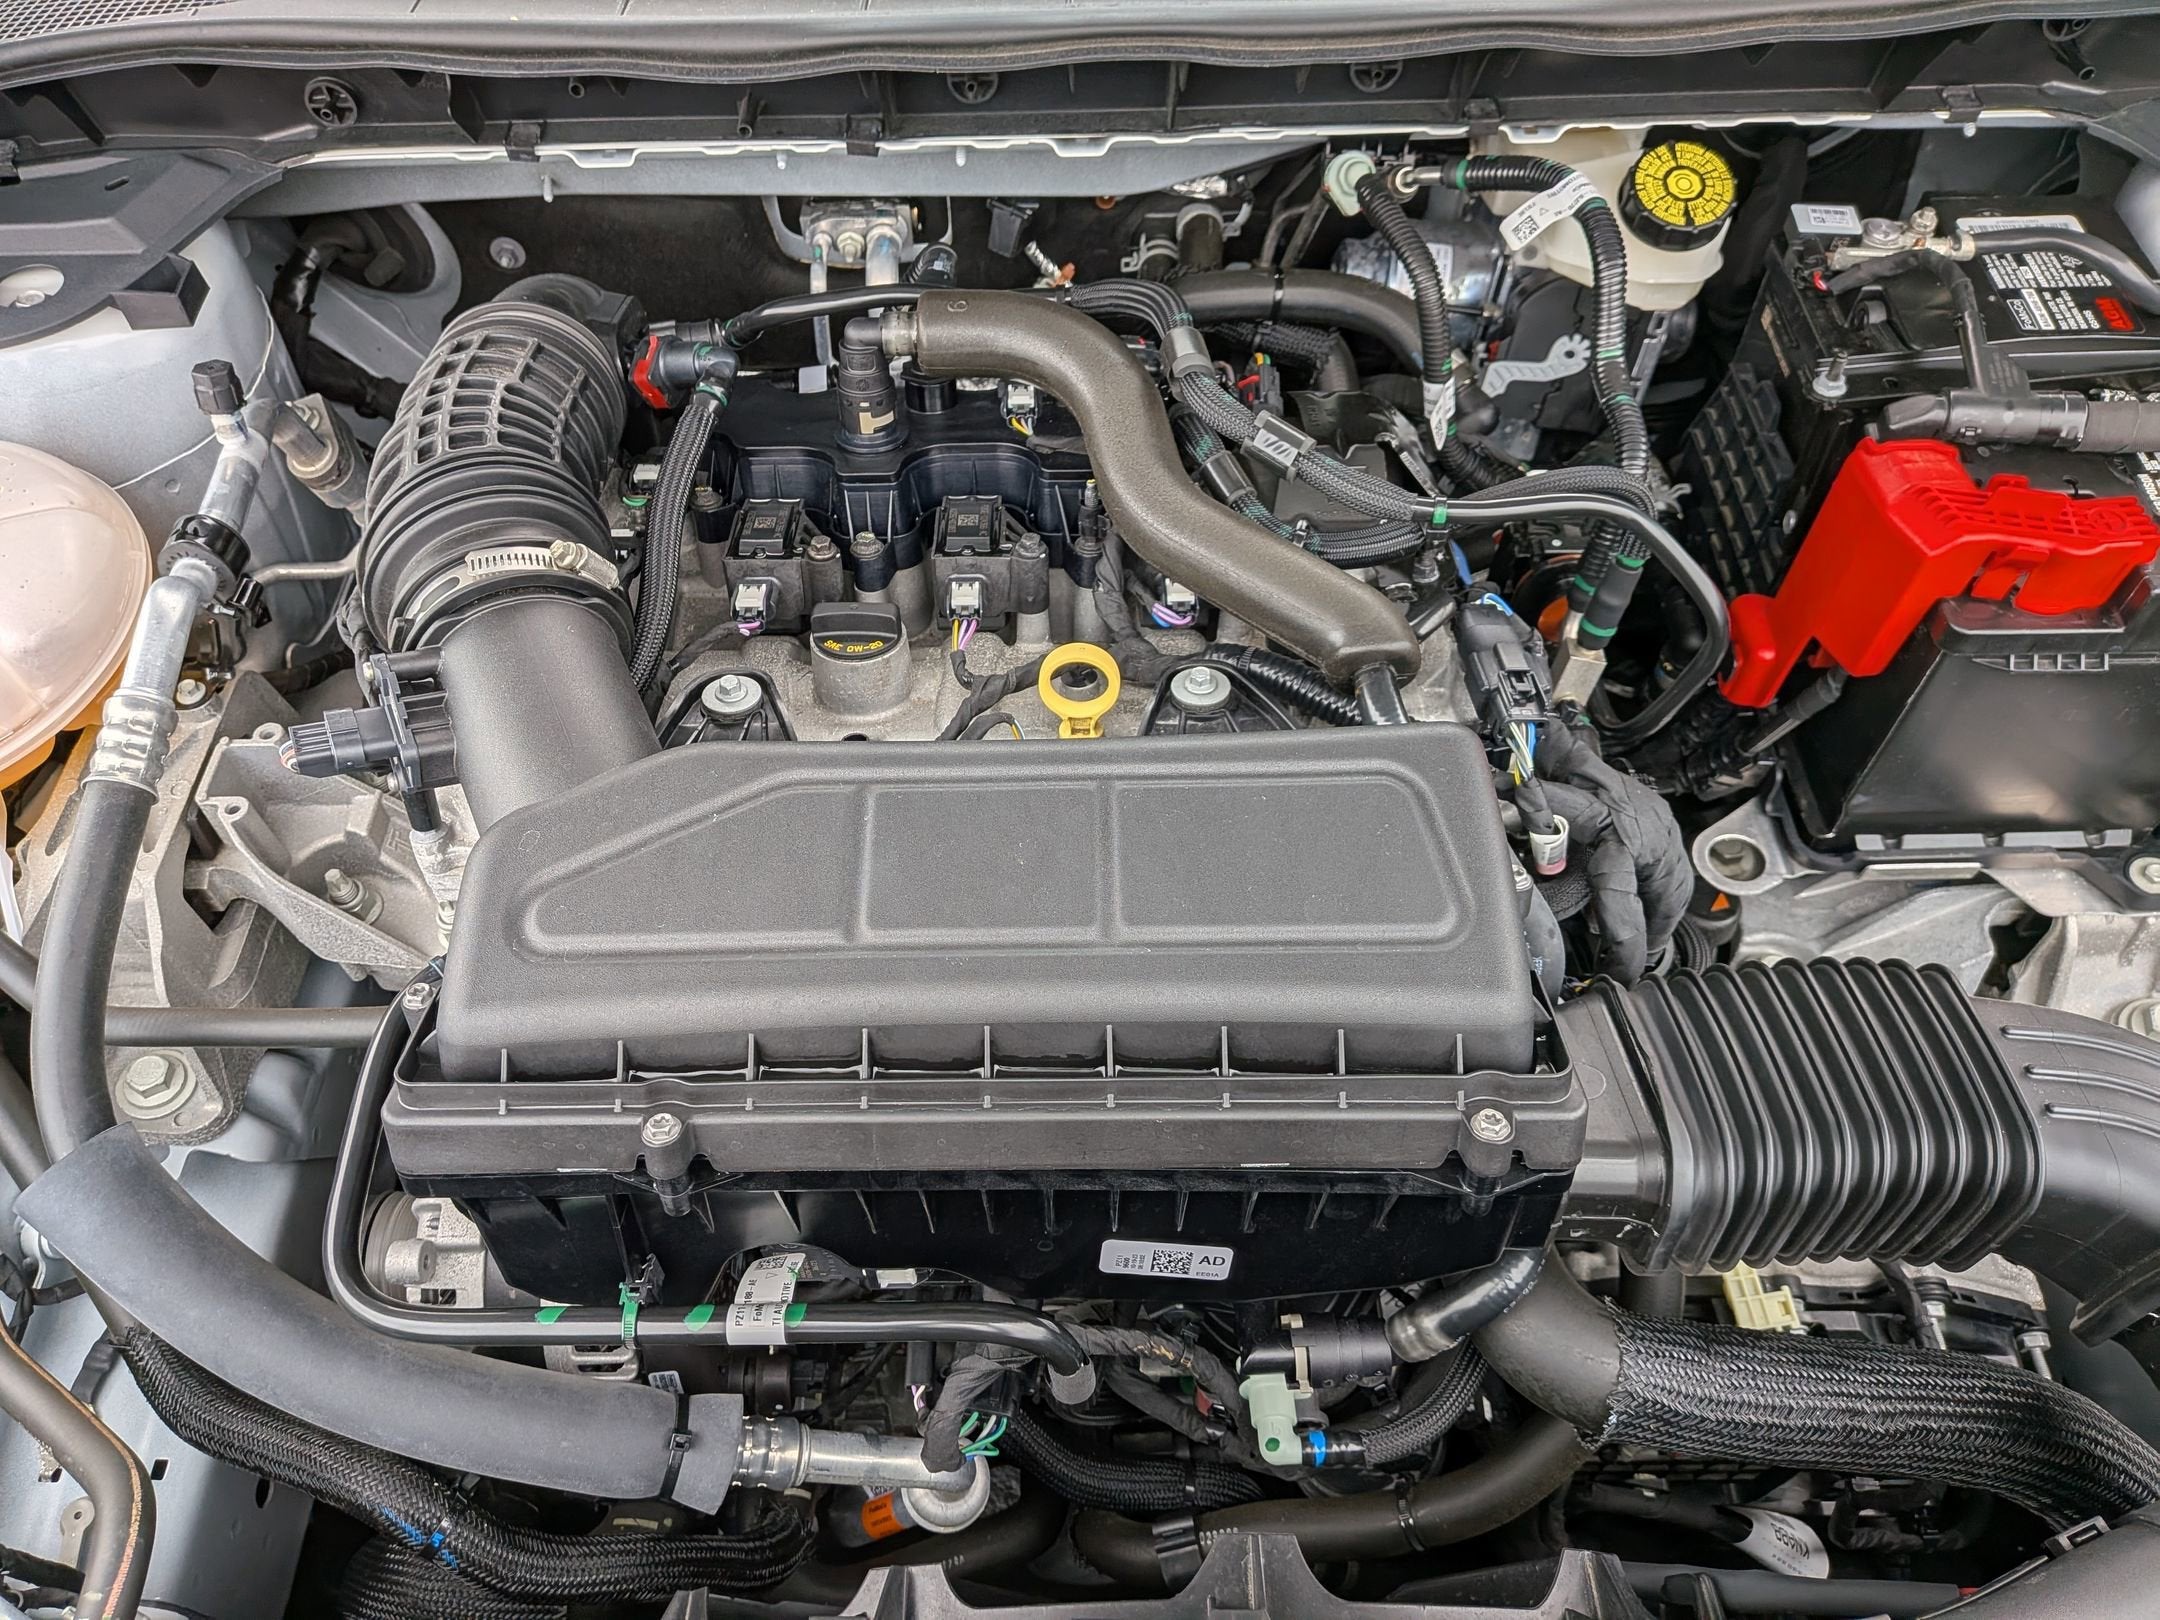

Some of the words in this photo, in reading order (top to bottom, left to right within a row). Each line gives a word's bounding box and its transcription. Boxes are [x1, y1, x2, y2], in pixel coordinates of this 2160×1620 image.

[2013, 299, 2034, 329] FoMoCo
[2095, 298, 2130, 331] AGM
[824, 639, 844, 652] SAE
[846, 640, 884, 653] 0W-20
[1199, 1255, 1226, 1267] AD
